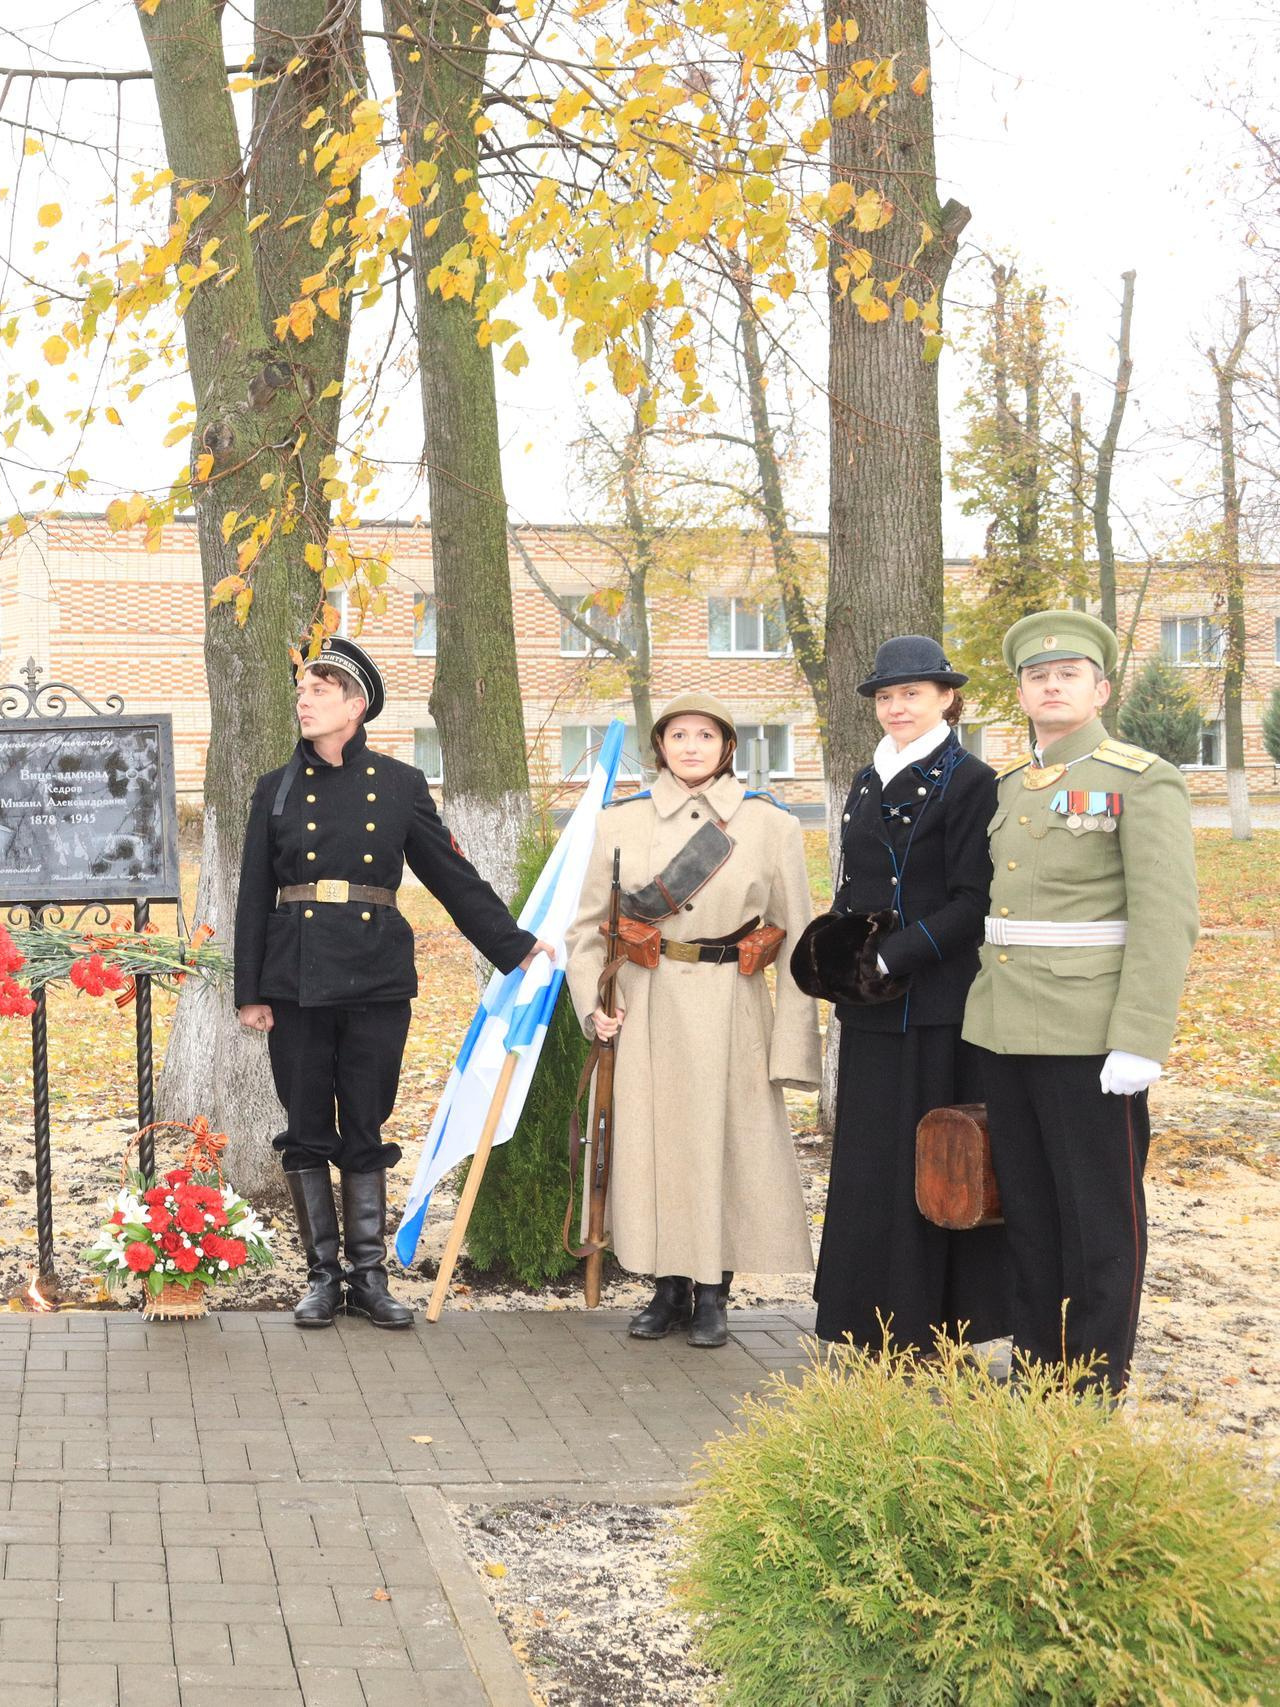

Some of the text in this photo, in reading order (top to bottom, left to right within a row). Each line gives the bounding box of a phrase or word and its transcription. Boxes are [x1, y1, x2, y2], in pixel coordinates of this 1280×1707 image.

[20, 768, 109, 782] Вице-адмирал
[44, 783, 83, 795] Кедров
[1, 797, 127, 808] Михаил Александрович
[30, 815, 56, 825] 1878
[70, 814, 96, 824] 1945
